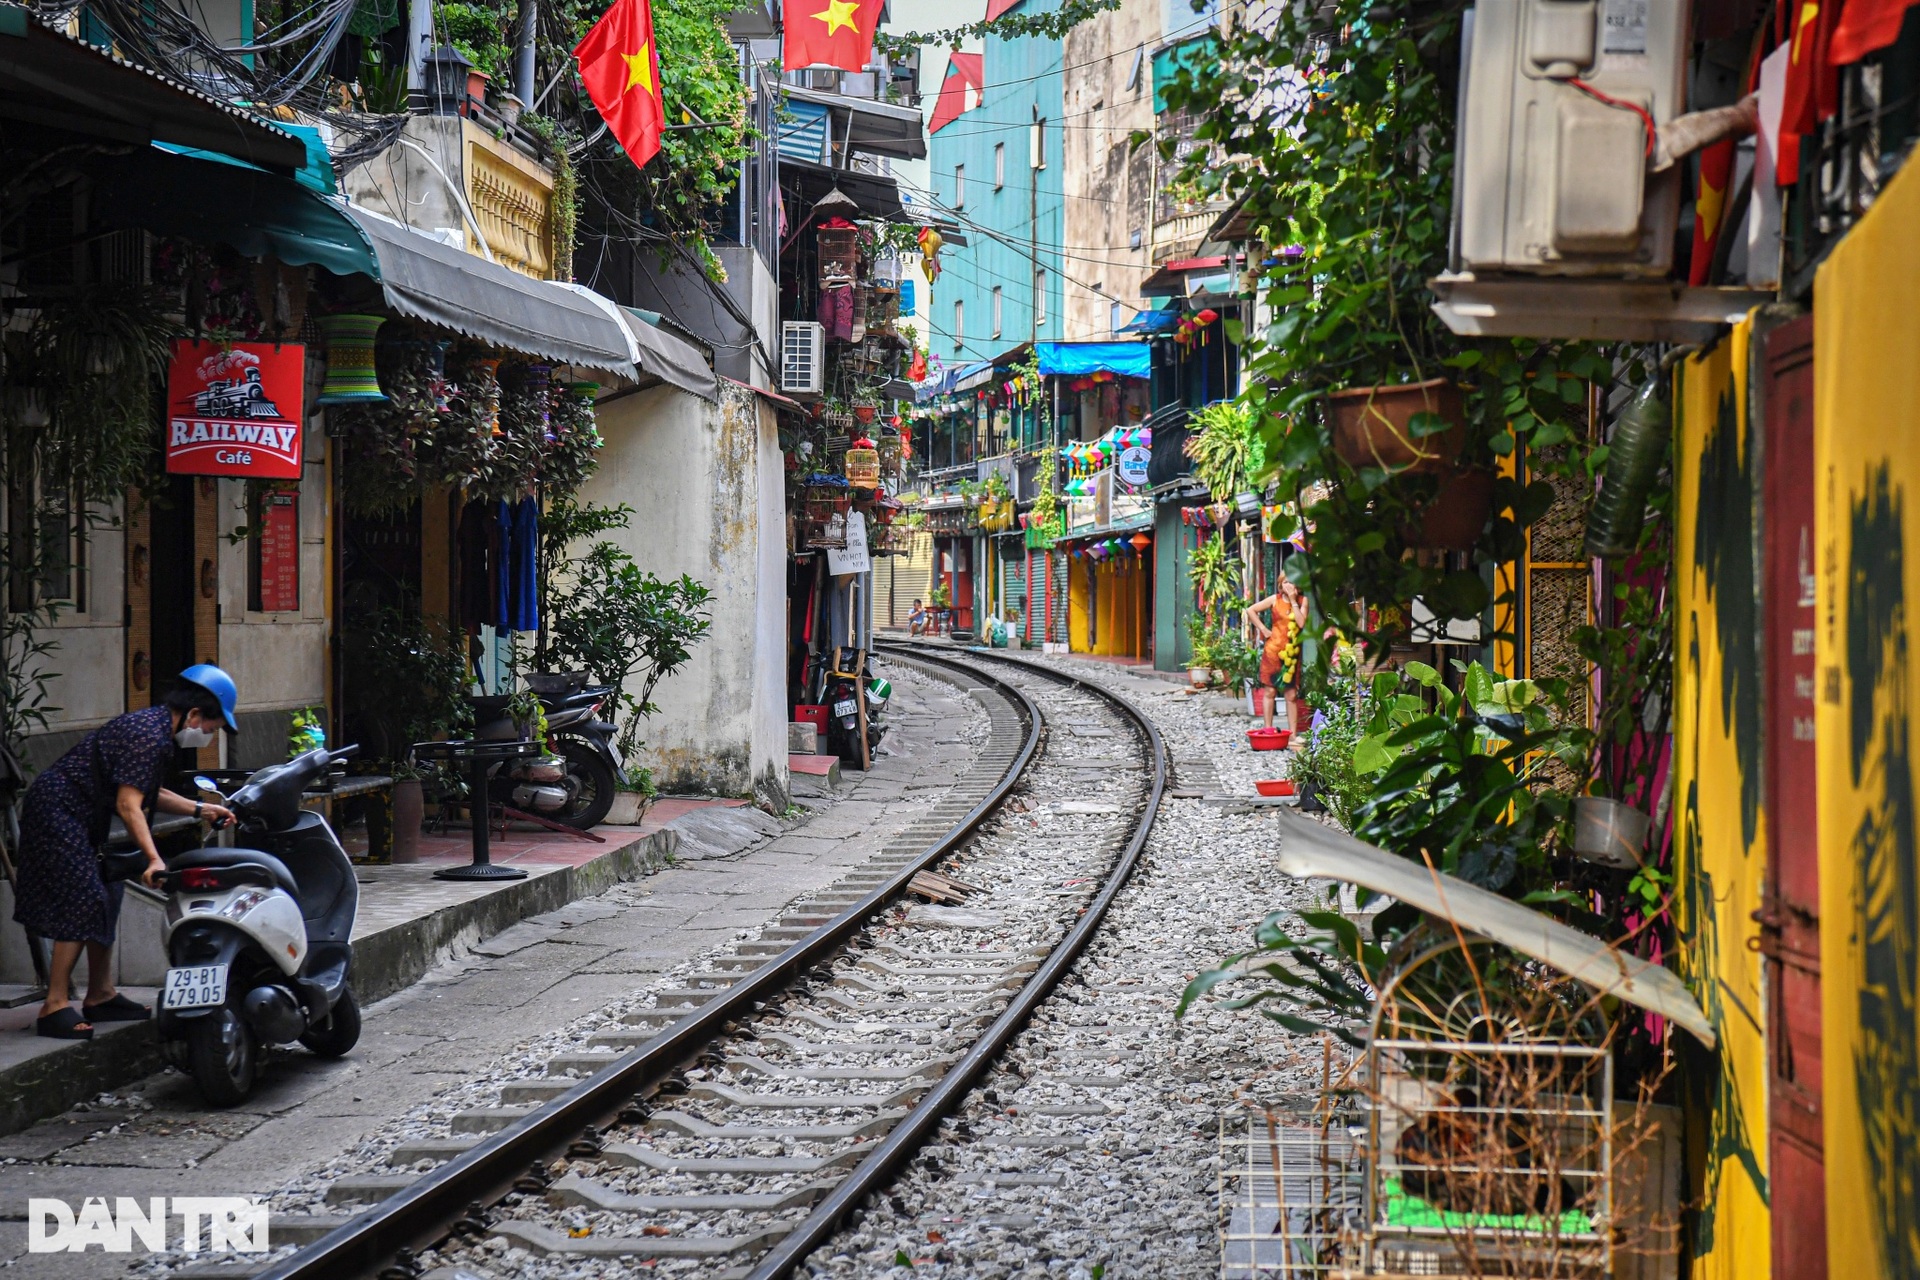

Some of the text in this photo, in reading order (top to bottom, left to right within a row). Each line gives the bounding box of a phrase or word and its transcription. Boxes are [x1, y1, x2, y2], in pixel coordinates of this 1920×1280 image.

[170, 421, 297, 452] RAILWAY
[216, 449, 251, 465] Café
[174, 967, 217, 988] 29-B1
[167, 985, 221, 1007] 479.05
